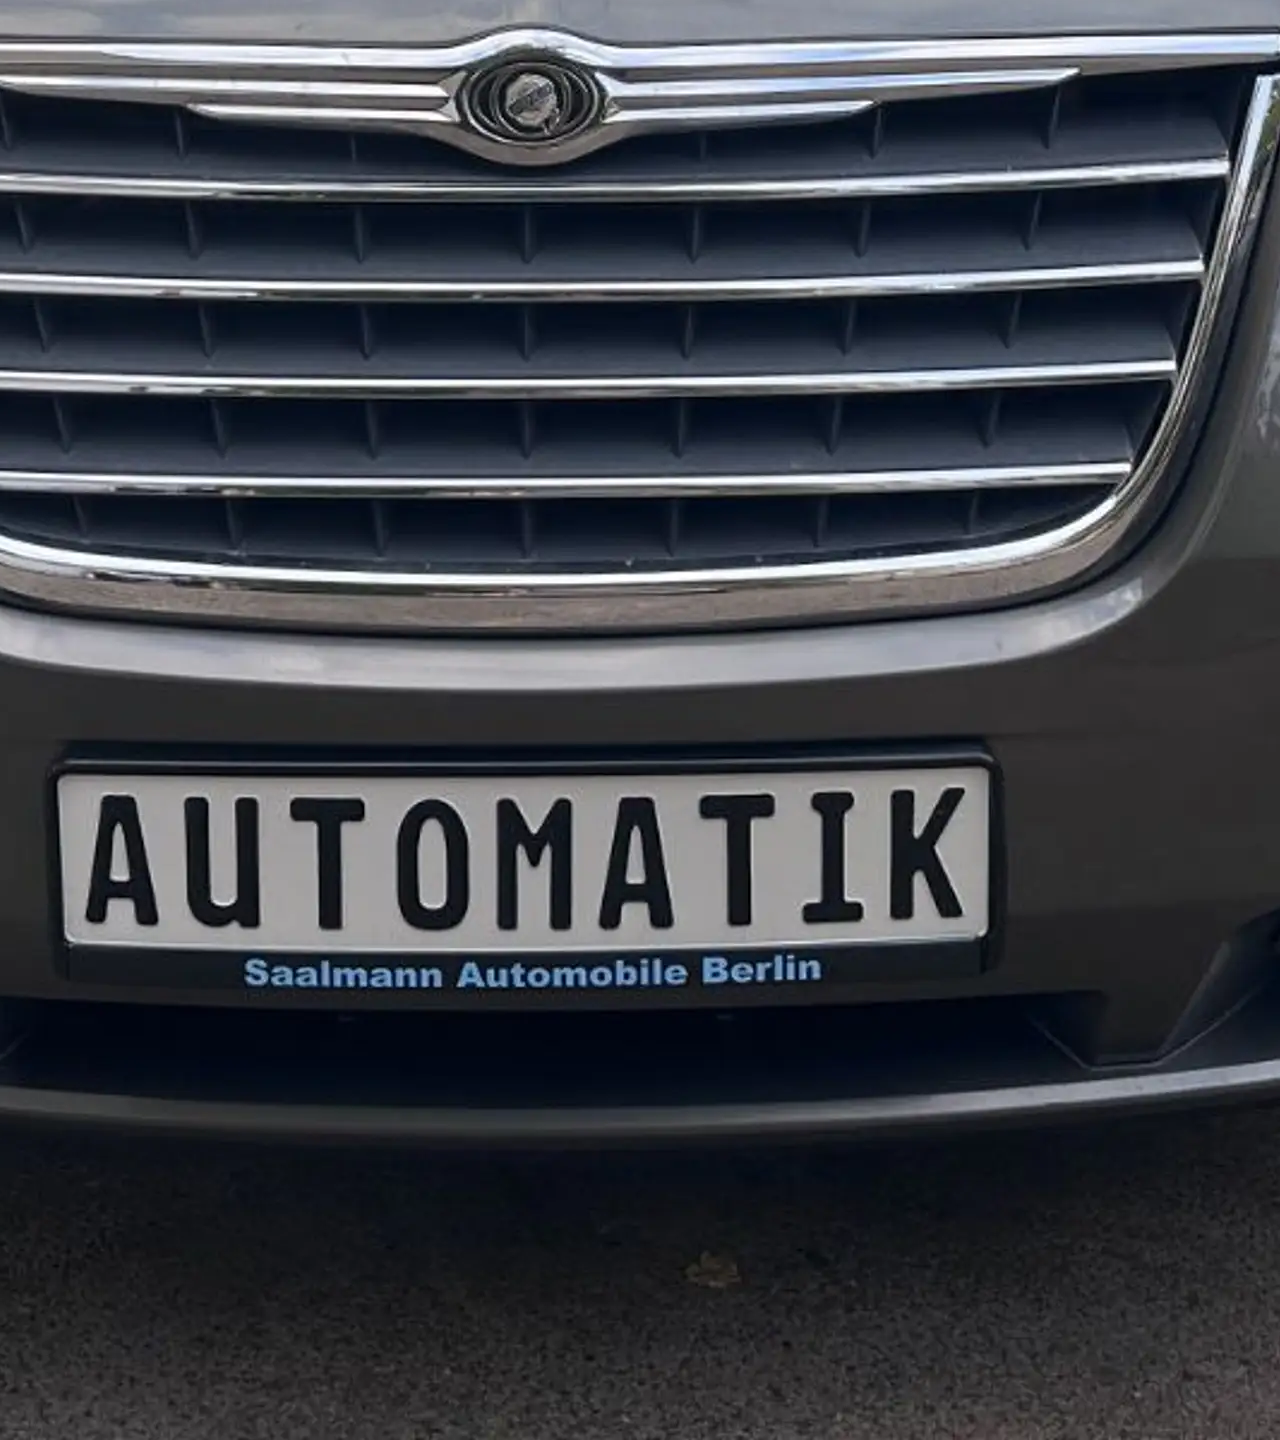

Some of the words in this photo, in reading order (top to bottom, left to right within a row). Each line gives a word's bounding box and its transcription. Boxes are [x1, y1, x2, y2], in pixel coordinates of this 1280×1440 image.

[84, 786, 967, 933] AUTOMATIK
[243, 958, 442, 988] Saalmann
[456, 957, 688, 989] Automobile
[701, 953, 821, 985] Berlin
